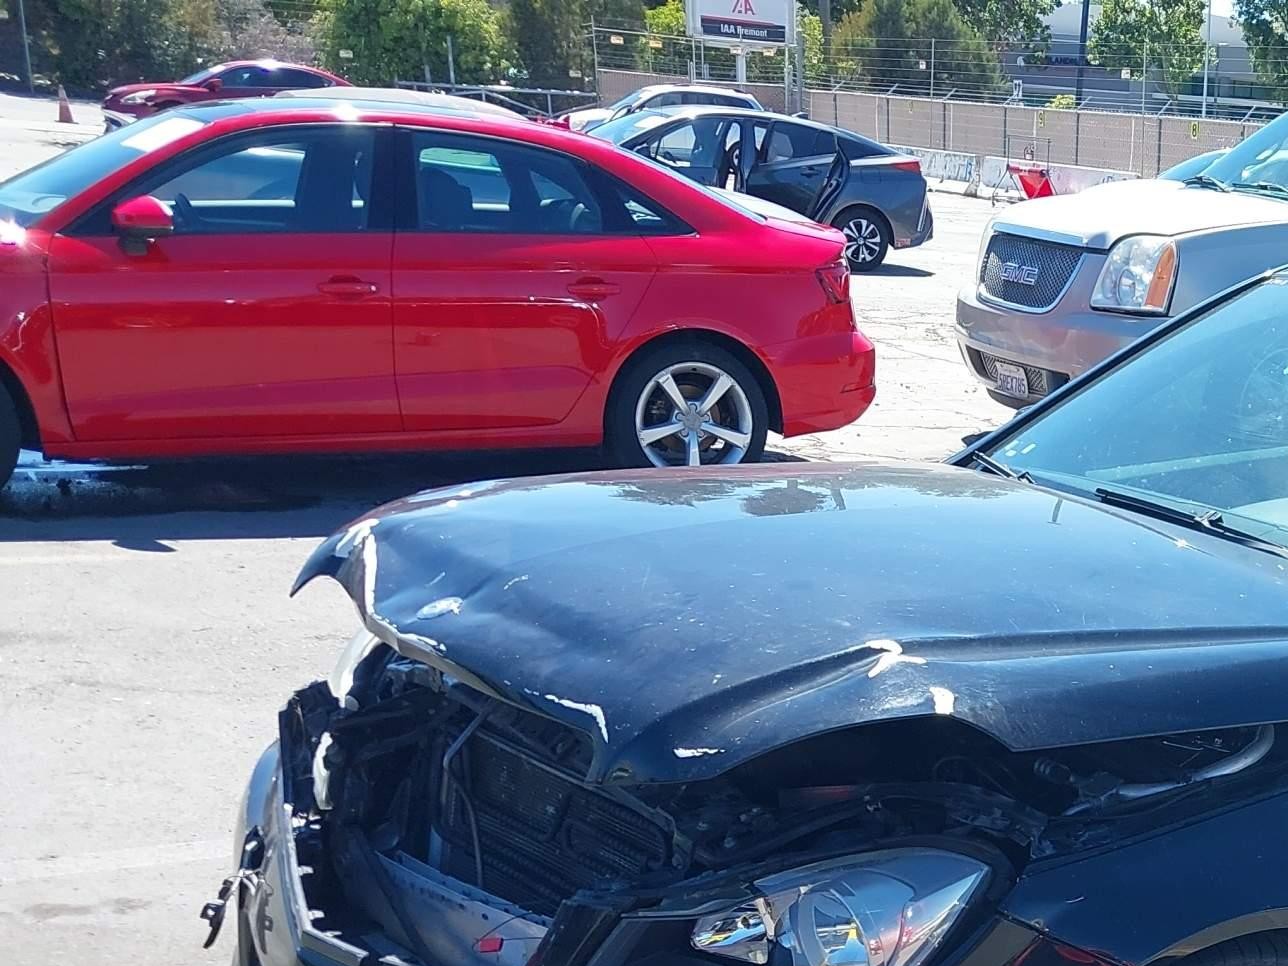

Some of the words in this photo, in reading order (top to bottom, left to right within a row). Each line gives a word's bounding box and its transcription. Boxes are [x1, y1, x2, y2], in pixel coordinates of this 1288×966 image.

[720, 24, 736, 34] IAA
[737, 26, 768, 37] Fremont
[1001, 262, 1038, 285] GMC
